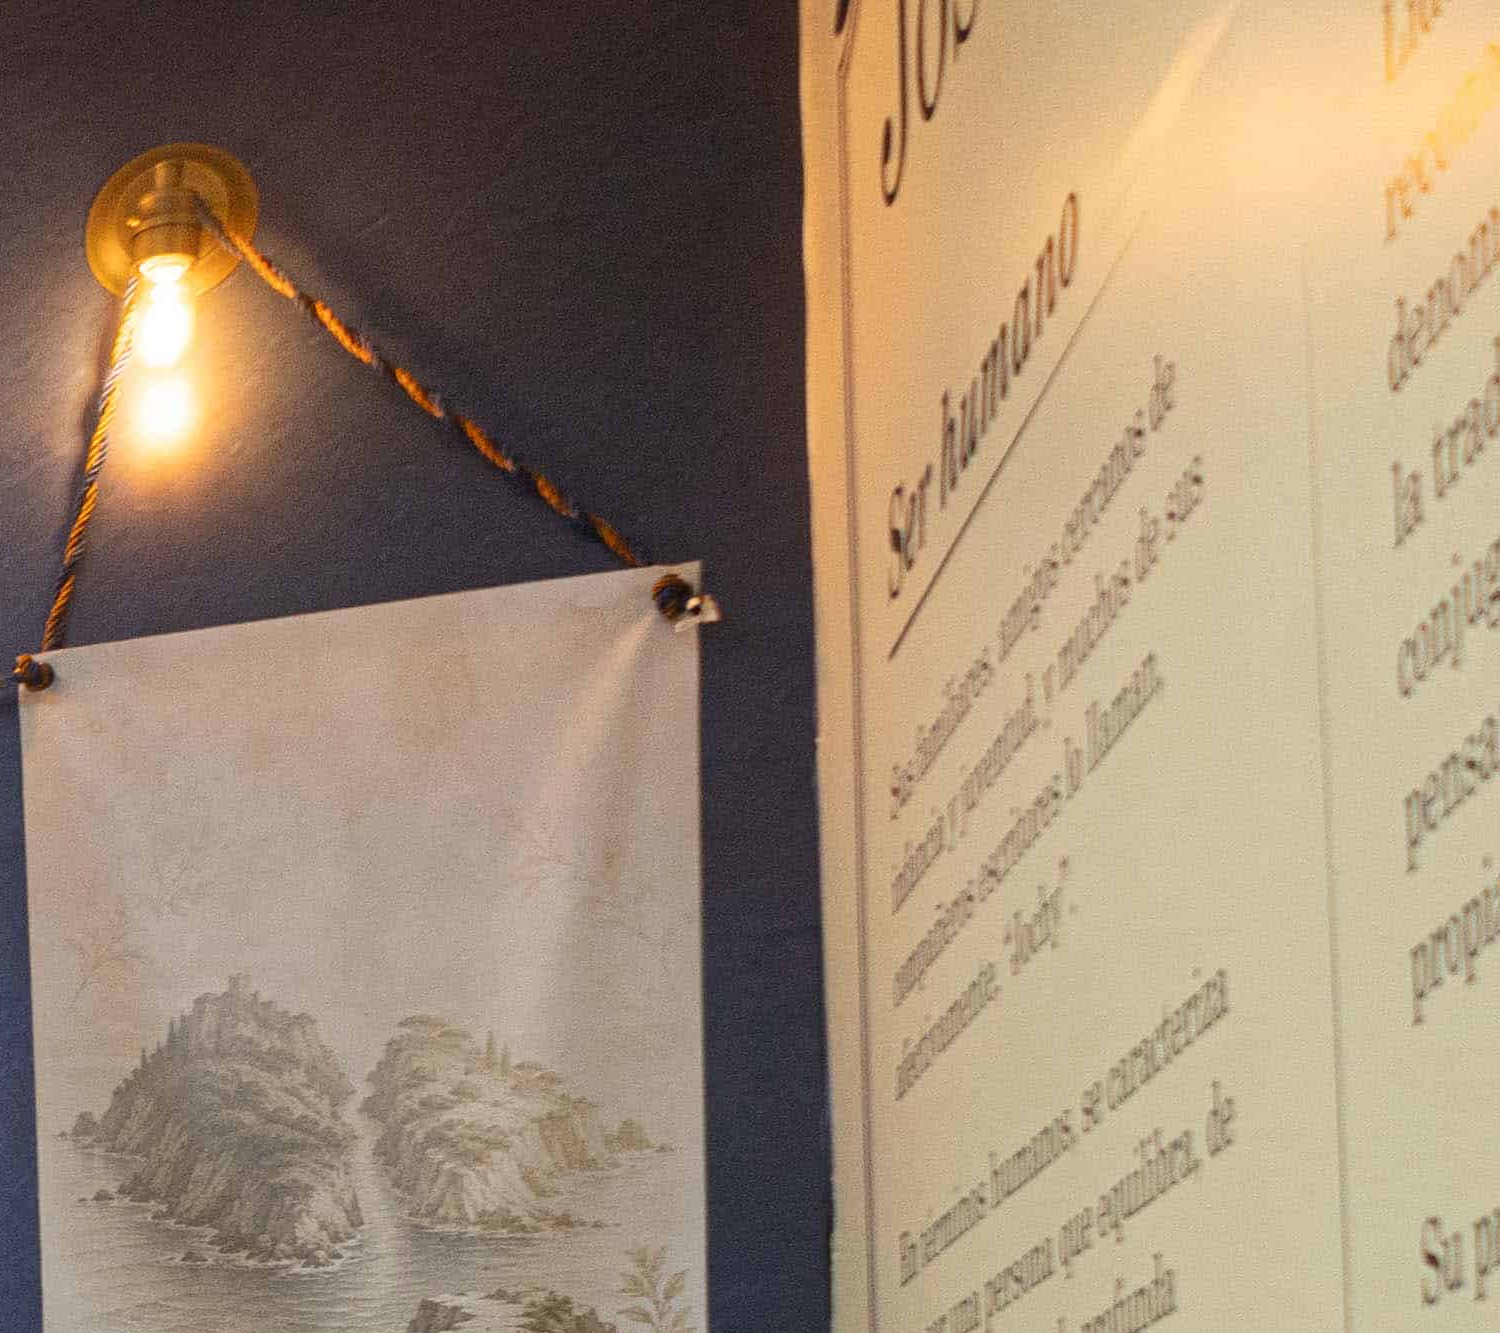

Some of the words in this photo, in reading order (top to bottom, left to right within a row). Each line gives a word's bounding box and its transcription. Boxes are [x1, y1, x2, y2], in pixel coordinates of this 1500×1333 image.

[888, 460, 934, 602] Ser
[939, 190, 1079, 512] humano
[1420, 1214, 1464, 1308] Su
